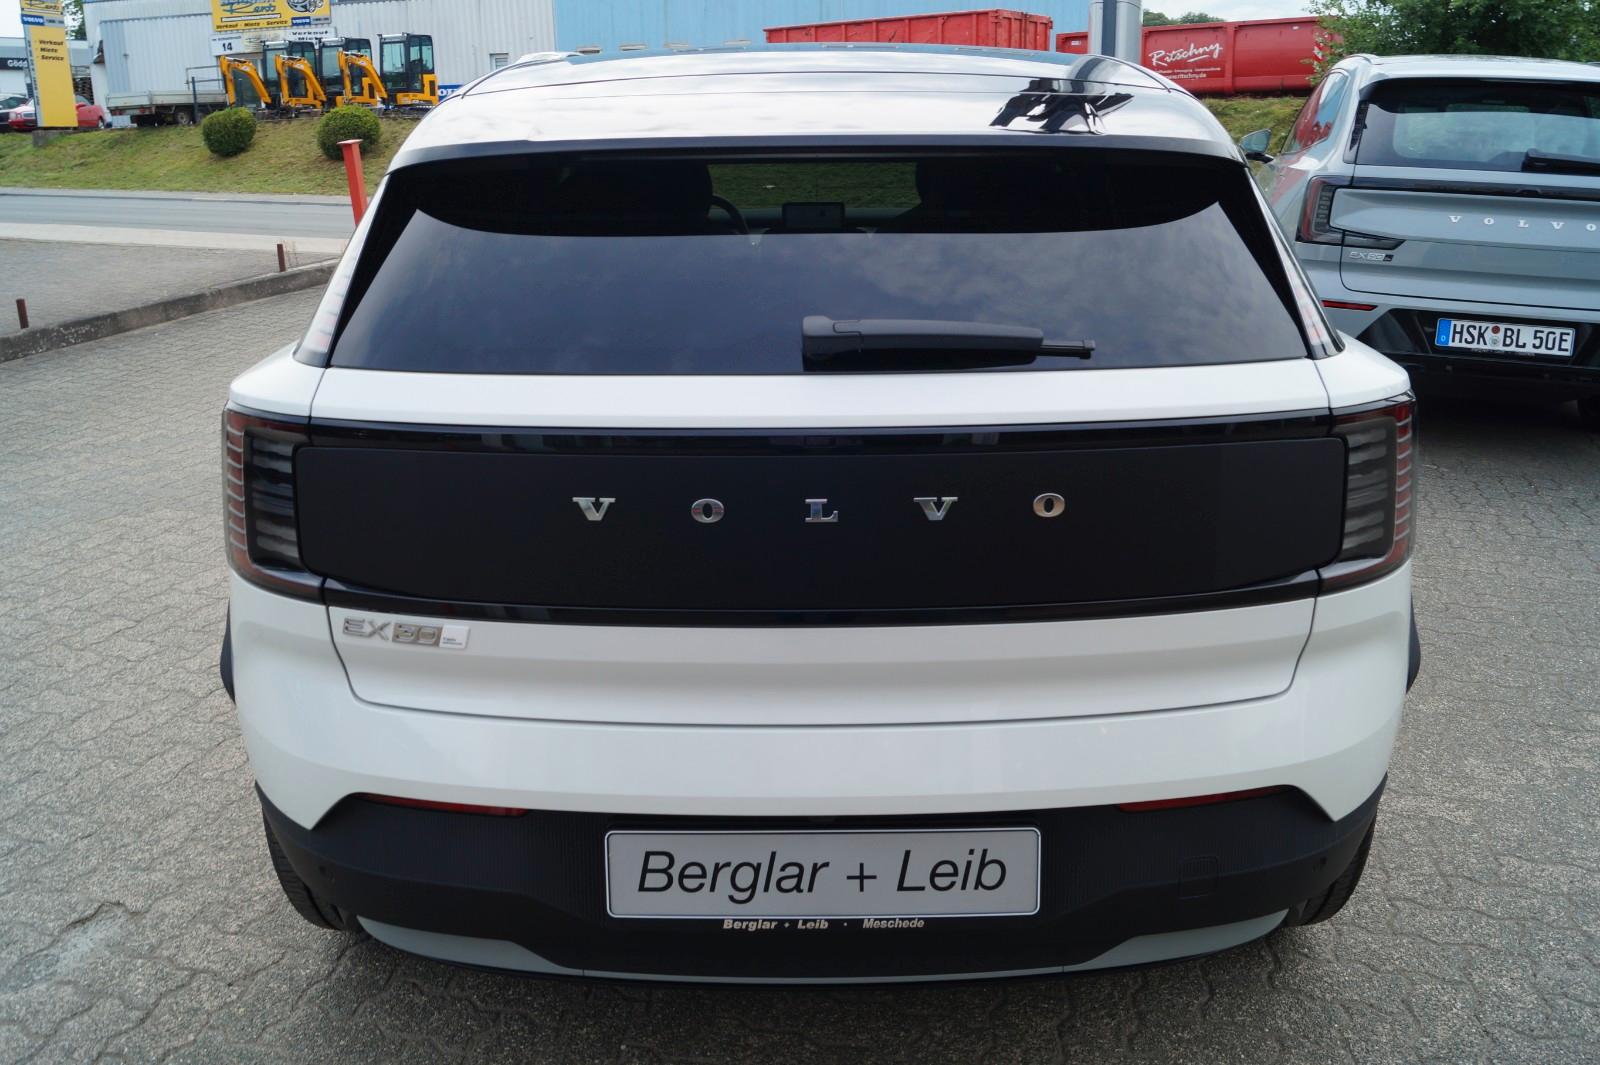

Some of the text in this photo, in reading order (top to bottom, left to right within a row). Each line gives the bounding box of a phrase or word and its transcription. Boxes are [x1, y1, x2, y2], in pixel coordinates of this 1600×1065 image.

[222, 42, 232, 51] 14
[1449, 215, 1597, 231] VOLVO
[1452, 323, 1571, 352] HSK BL 50E
[572, 492, 1066, 524] VOLVO
[637, 848, 1007, 905] Berglar + Leib
[722, 918, 778, 932] Berglar
[797, 919, 829, 929] Leib
[862, 917, 925, 929] Meschede
